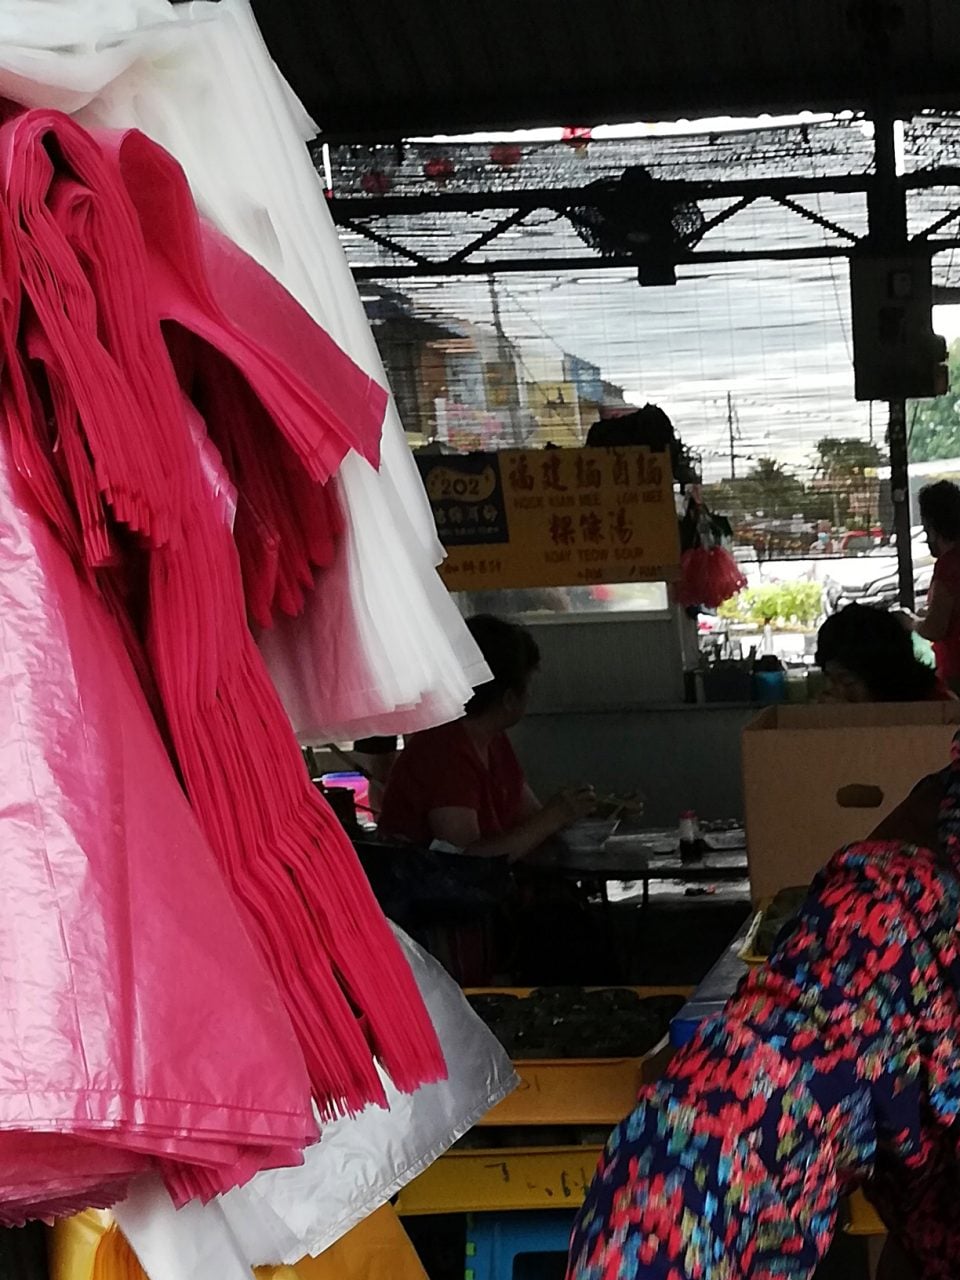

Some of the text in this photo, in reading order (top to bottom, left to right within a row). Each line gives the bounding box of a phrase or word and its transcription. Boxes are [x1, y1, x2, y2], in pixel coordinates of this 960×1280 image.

[440, 478, 480, 496] 202
[578, 548, 609, 562] TEOW
[614, 547, 644, 560] SOUP
